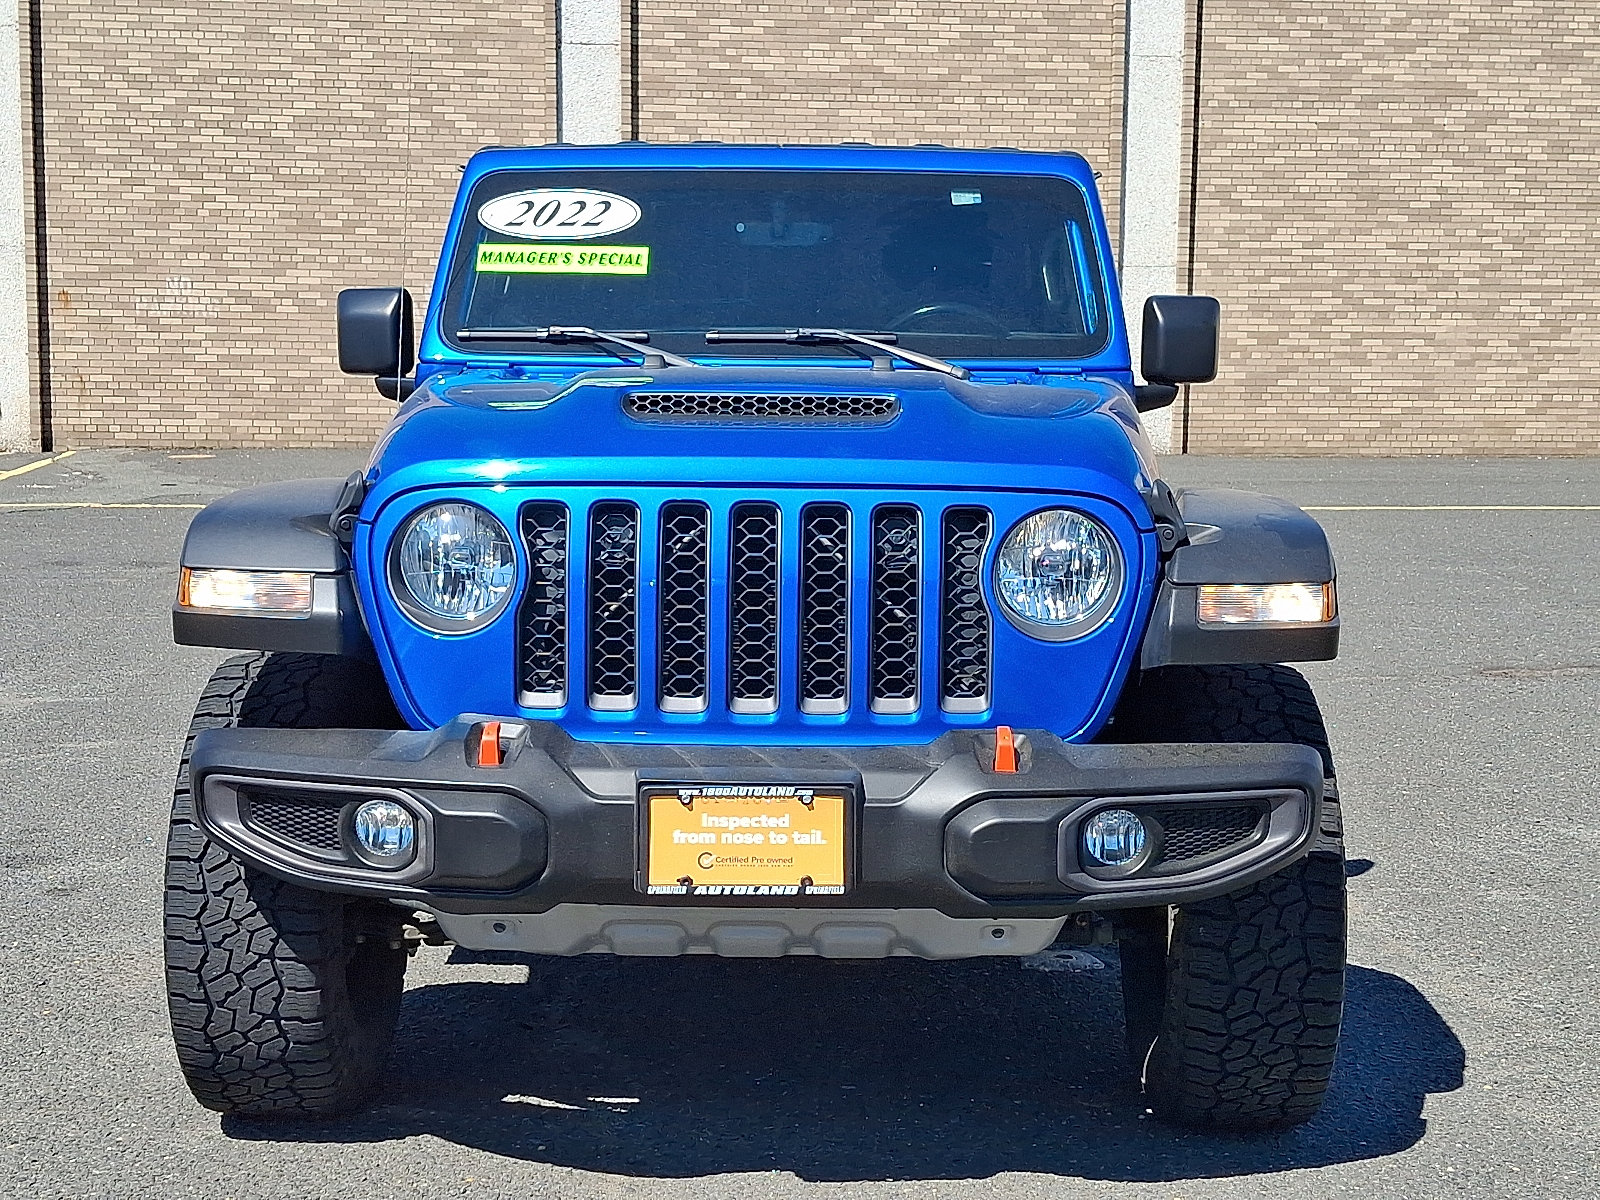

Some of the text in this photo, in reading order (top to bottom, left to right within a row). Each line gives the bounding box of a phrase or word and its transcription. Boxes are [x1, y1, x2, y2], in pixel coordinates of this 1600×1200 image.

[504, 200, 612, 227] 2022
[480, 251, 643, 266] MANAGER'S SPECIAL
[701, 812, 790, 831] Inspected
[672, 829, 828, 845] from nose to tail.
[715, 856, 749, 864] Certified
[766, 856, 793, 864] owned
[693, 885, 799, 896] AUTOLAND
